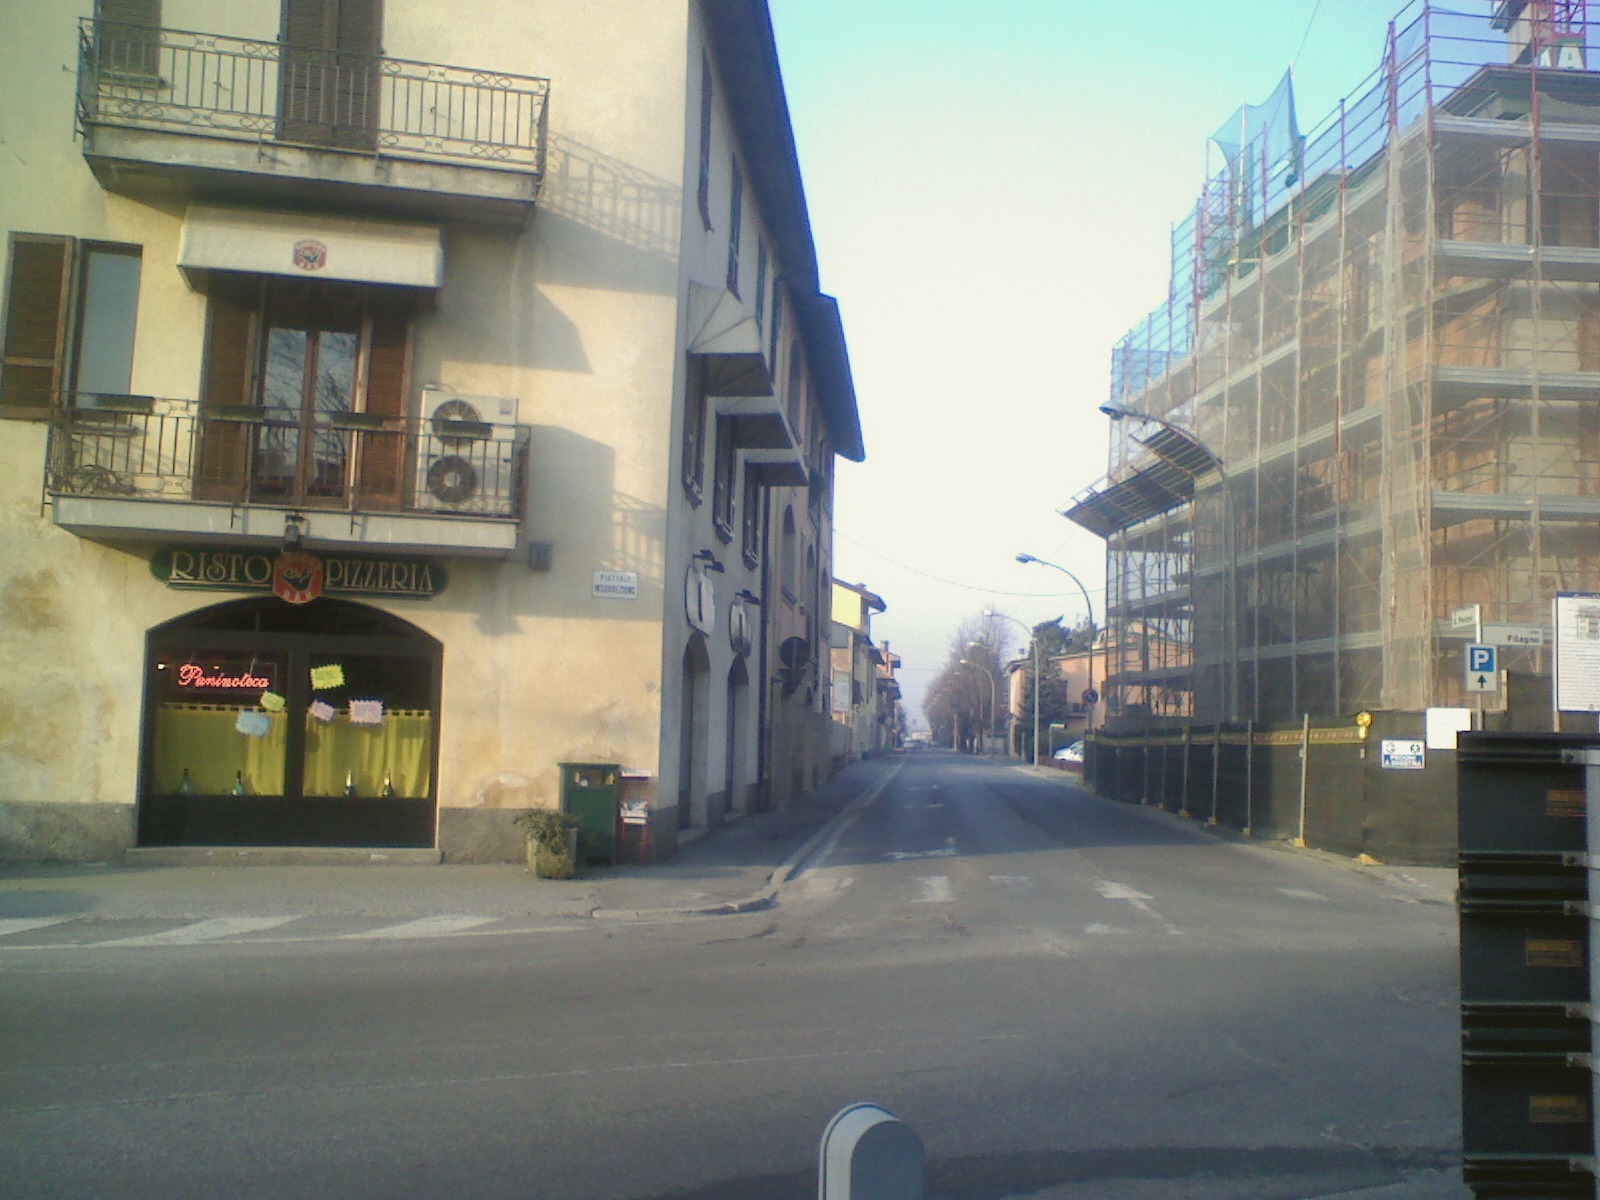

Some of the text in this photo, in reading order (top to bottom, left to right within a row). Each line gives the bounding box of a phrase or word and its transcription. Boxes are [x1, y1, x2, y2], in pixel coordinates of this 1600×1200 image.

[171, 552, 433, 591] RISTO PIZZERIA
[1473, 649, 1490, 670] P
